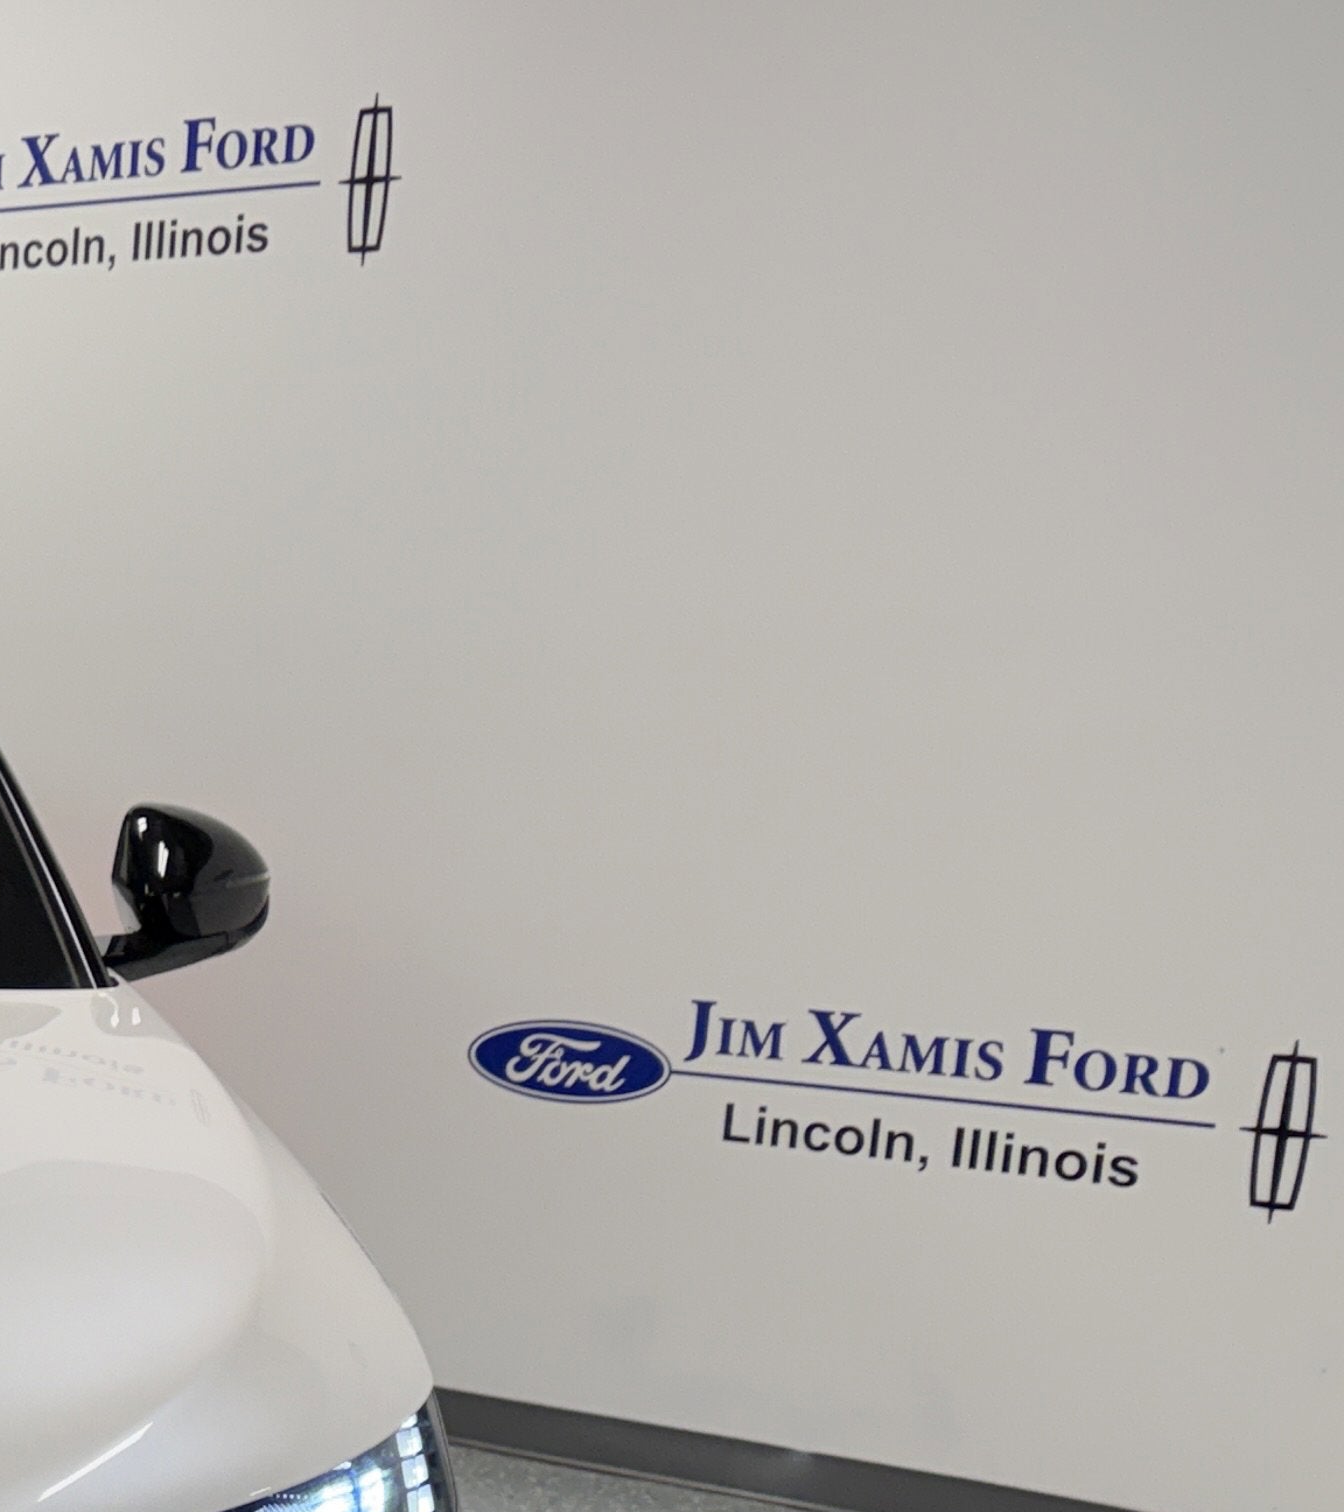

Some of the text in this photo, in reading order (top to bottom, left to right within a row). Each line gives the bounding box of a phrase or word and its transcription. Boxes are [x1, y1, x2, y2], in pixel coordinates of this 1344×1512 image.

[17, 132, 166, 188] XAMIS
[180, 117, 316, 173] FORD
[131, 213, 270, 262] Illinois
[505, 1031, 627, 1094] Ford
[683, 999, 1210, 1100] JIM XAMIS FORD
[721, 1101, 1140, 1188] Lincoln, Illinois
